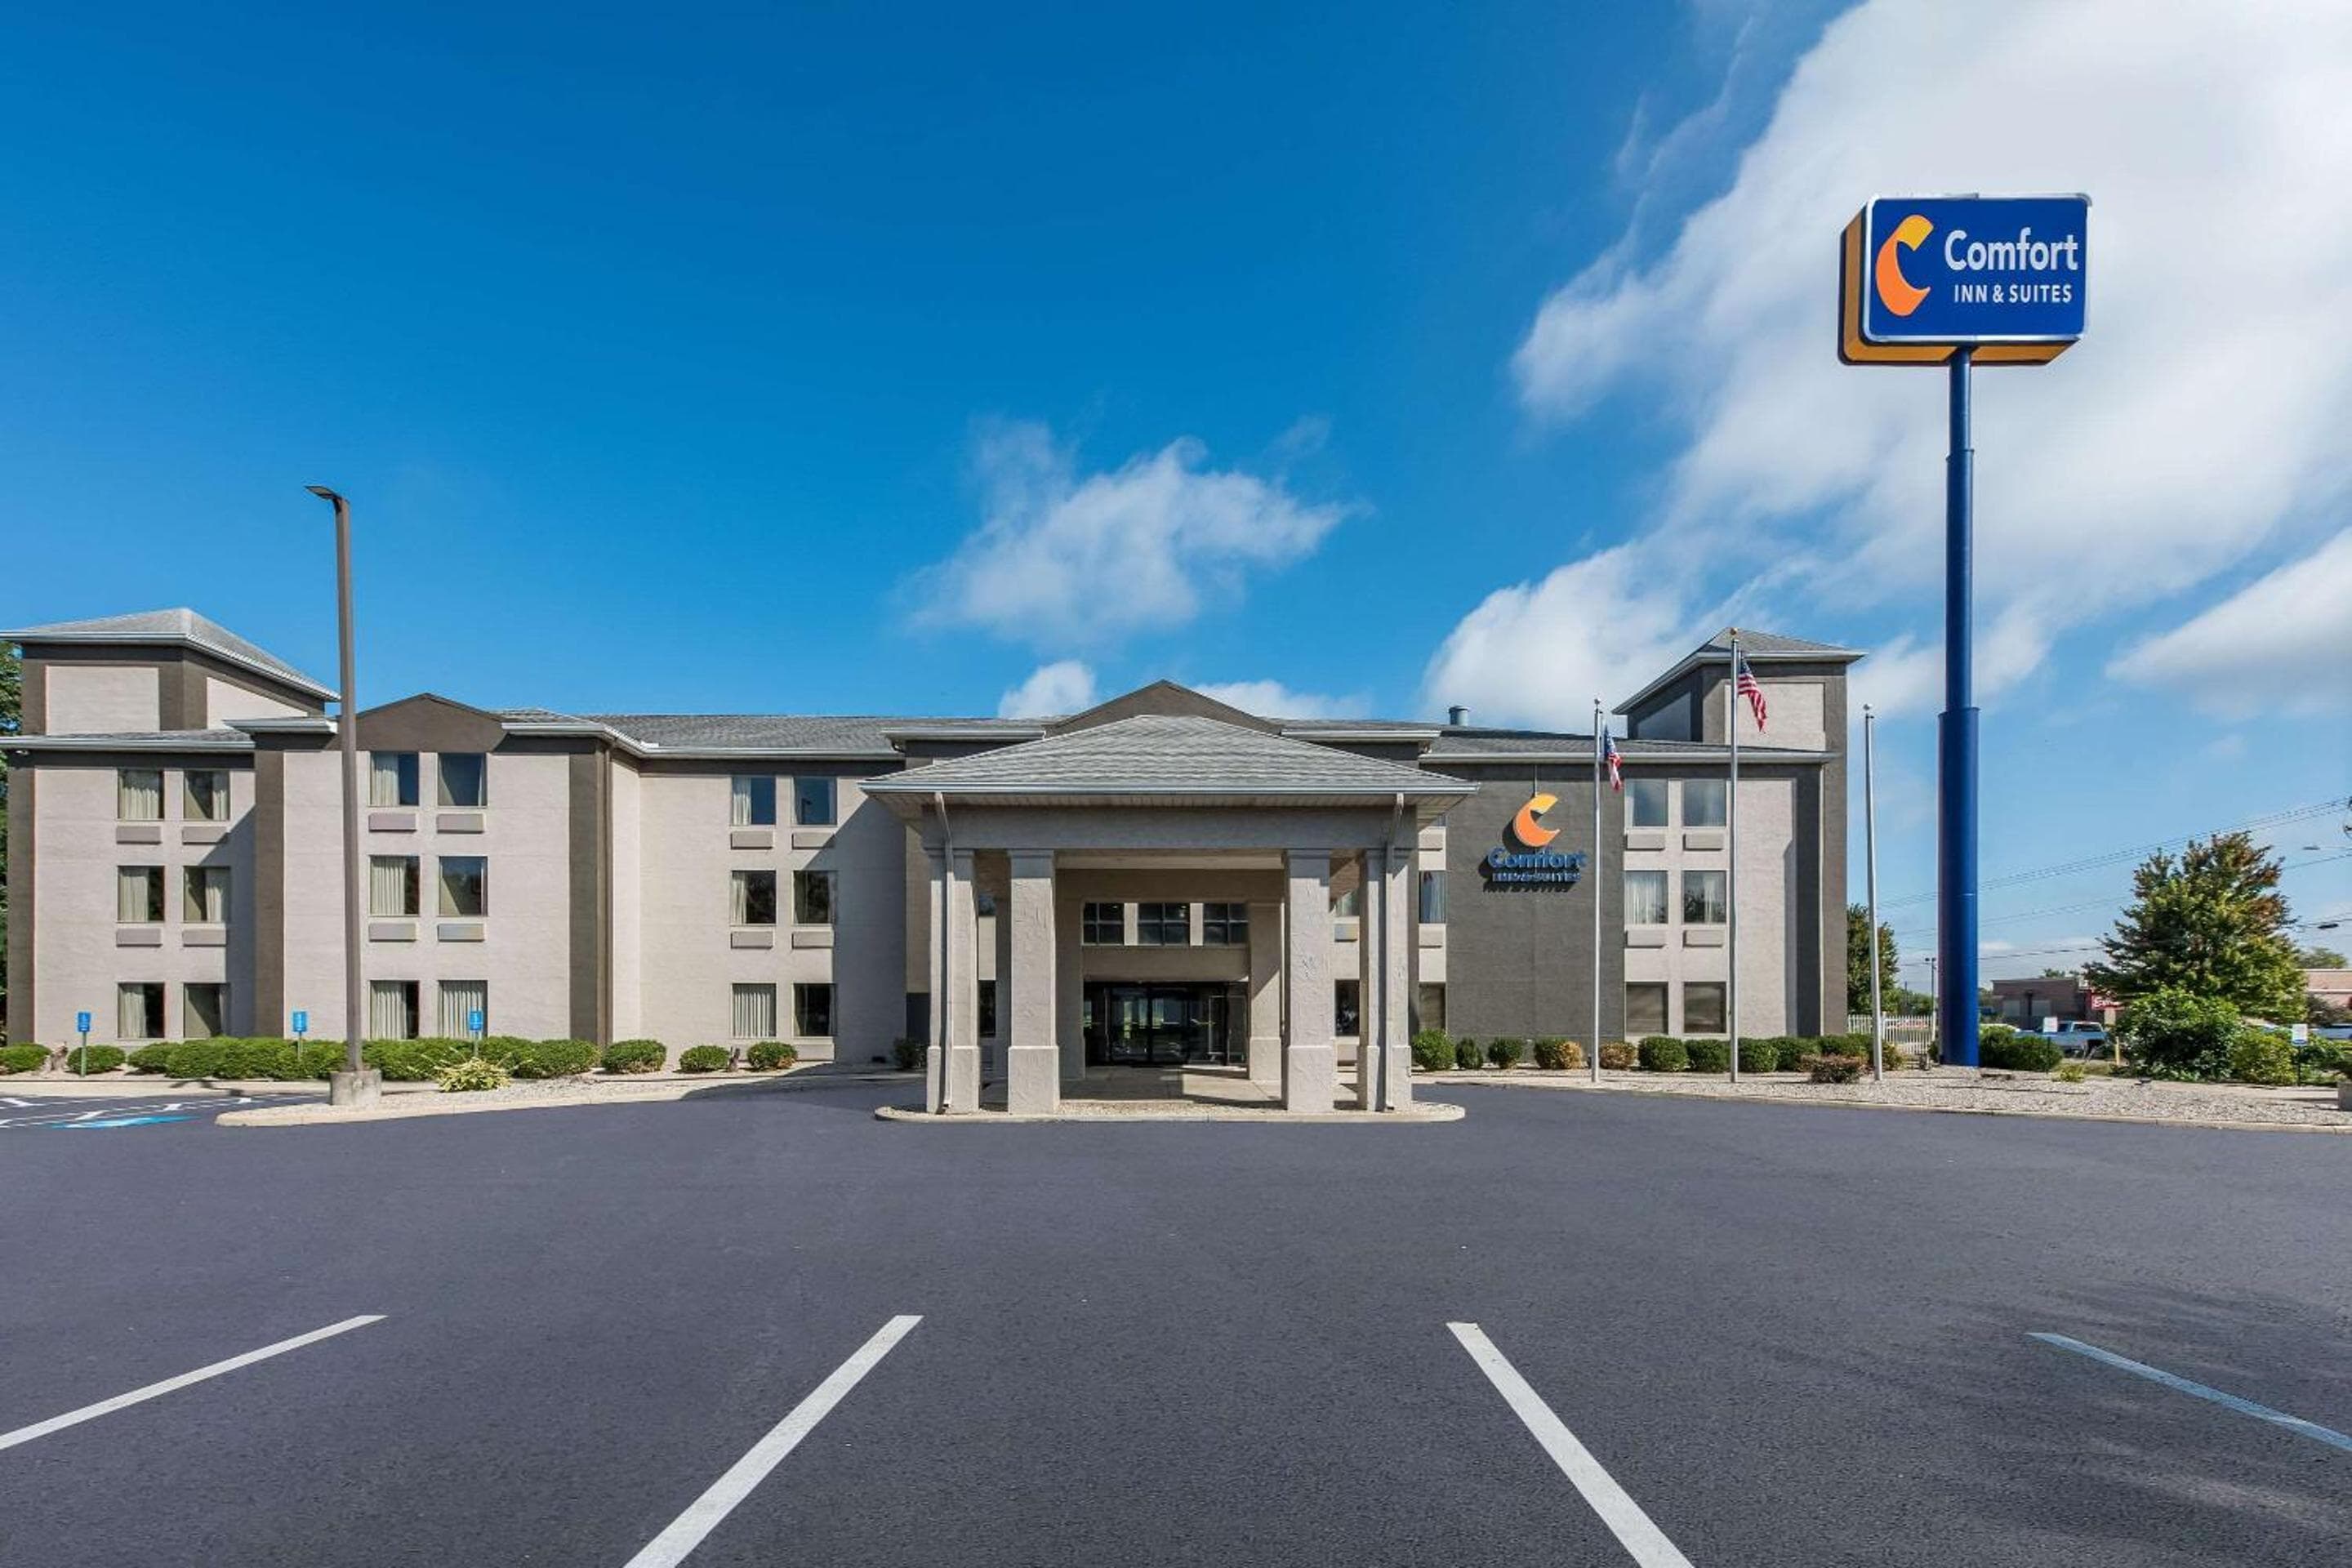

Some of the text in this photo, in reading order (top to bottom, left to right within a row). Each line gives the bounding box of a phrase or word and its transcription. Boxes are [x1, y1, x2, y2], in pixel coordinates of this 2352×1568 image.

[1944, 227, 2078, 270] Comfort
[1954, 284, 2072, 303] INN & SUITES
[1488, 845, 1587, 868] Comfort
